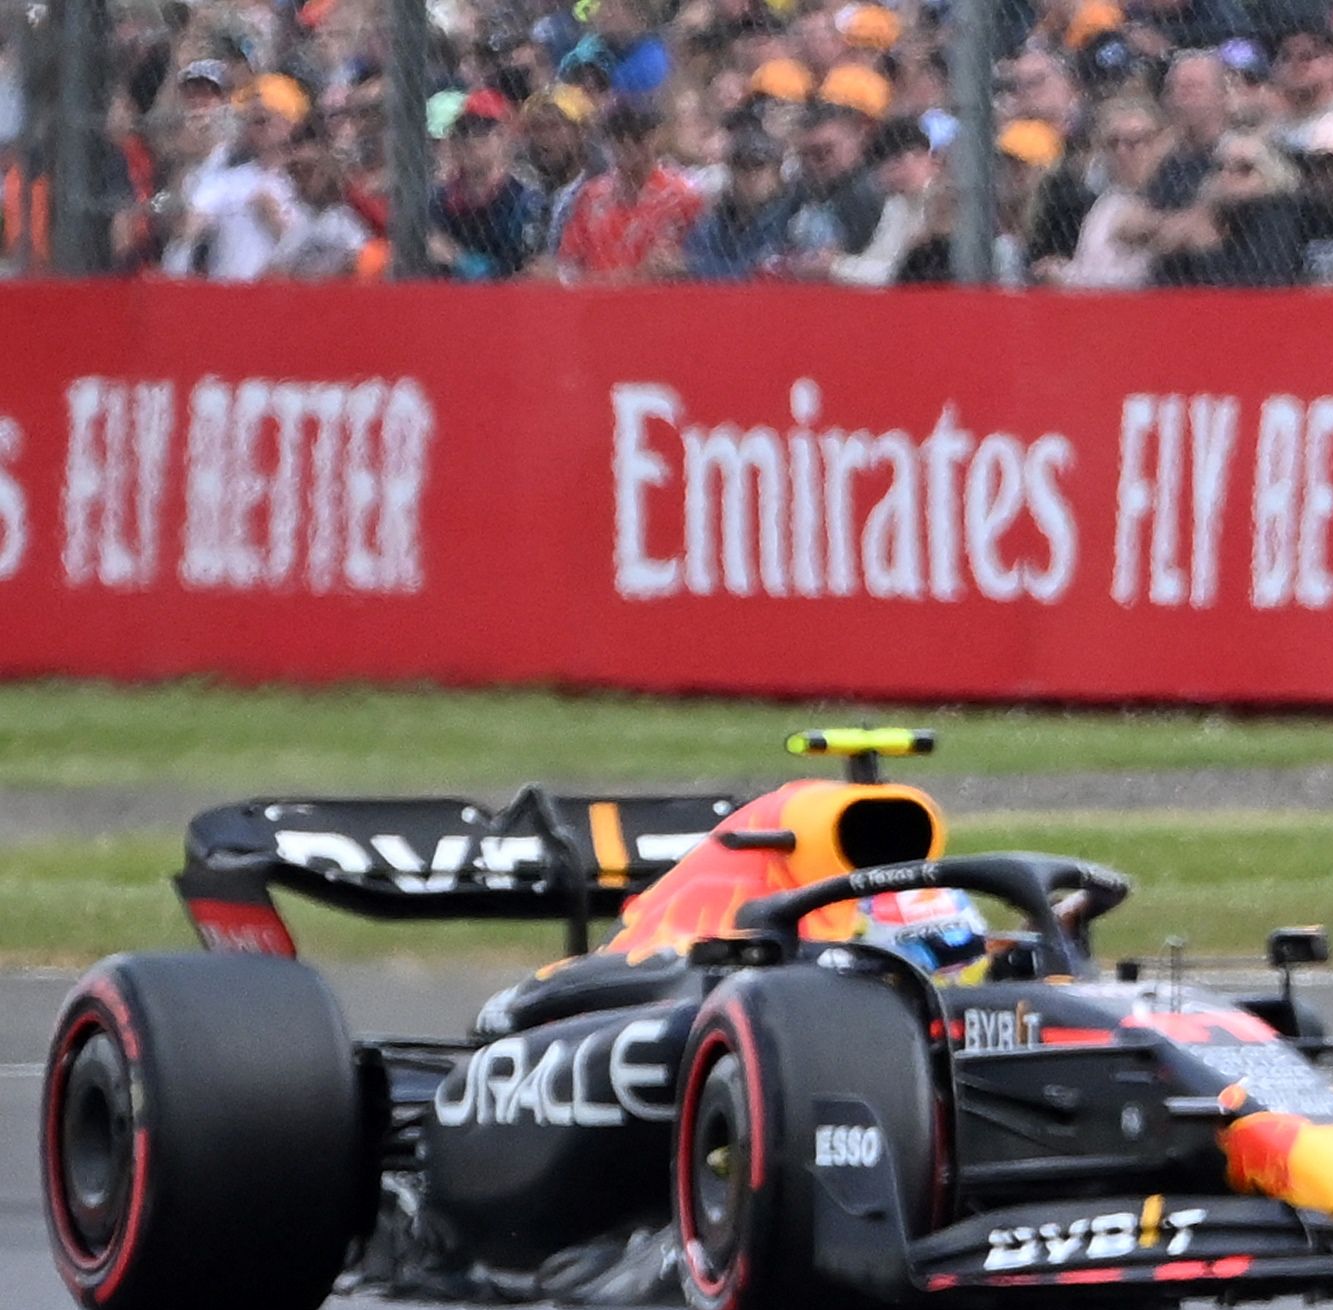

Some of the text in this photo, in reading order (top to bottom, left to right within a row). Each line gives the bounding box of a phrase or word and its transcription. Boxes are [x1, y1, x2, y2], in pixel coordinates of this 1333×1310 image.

[62, 375, 174, 588] FLY
[180, 375, 434, 595] BETTER
[611, 378, 1078, 602] Emirates
[1110, 392, 1241, 610] FLY
[815, 1126, 882, 1168] ESSO
